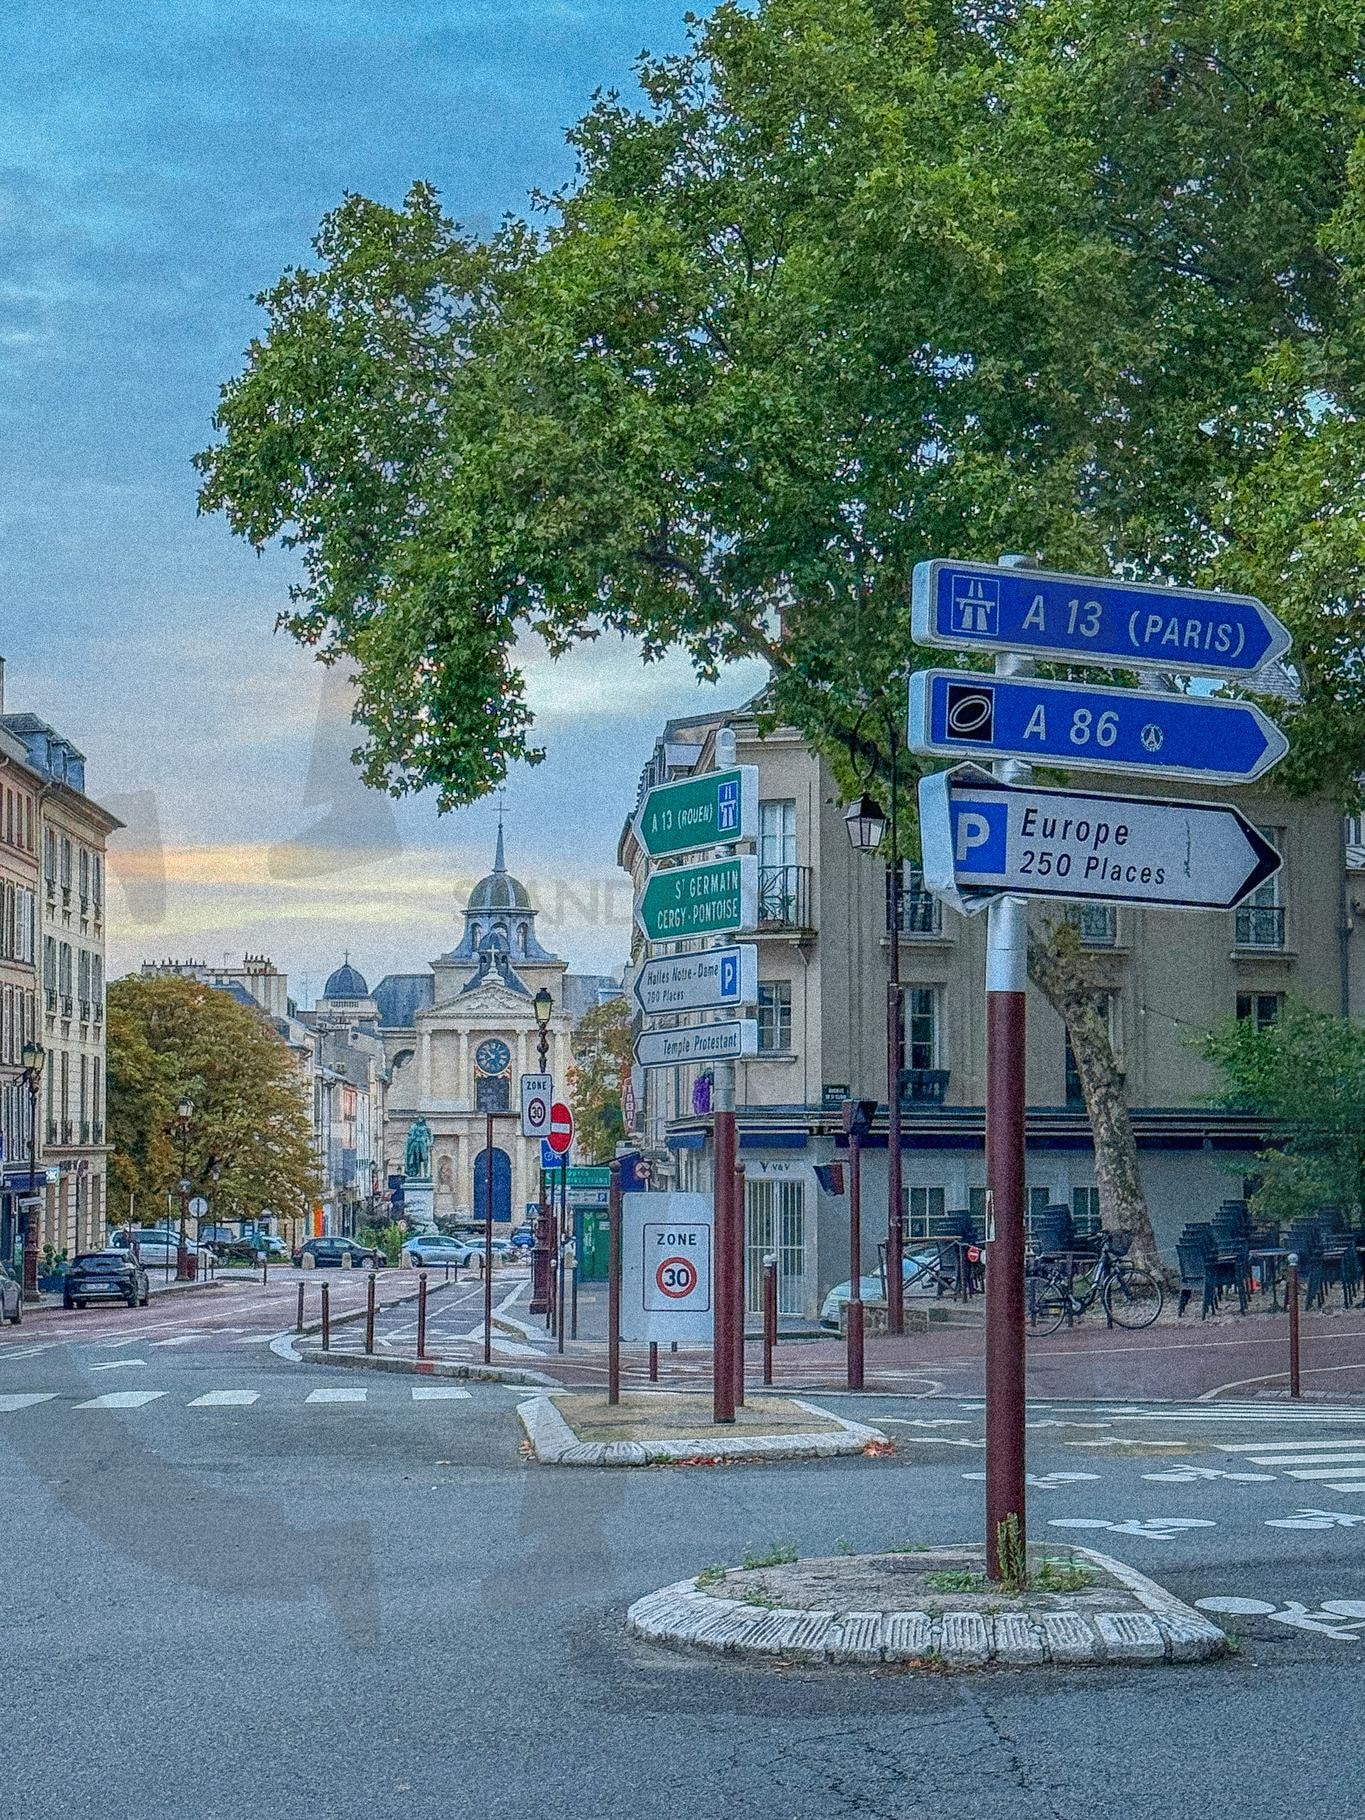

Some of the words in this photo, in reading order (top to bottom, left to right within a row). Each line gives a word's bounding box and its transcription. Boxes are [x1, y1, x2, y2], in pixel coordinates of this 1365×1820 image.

[1022, 594, 1046, 632] A
[1067, 599, 1103, 638] 13
[1129, 609, 1245, 658] (PARIS)
[1023, 703, 1047, 741] A
[1070, 707, 1119, 747] 86
[651, 813, 658, 833] A
[662, 809, 672, 831] 13
[677, 802, 713, 830] (ROUEN)
[1020, 808, 1129, 850] Europe
[956, 812, 991, 861] P
[1019, 849, 1071, 878] 250
[1084, 856, 1165, 886] Places
[689, 869, 738, 897] GERMAIN
[724, 962, 734, 990] P
[663, 989, 684, 1003] Places
[663, 1037, 690, 1057] Temple
[694, 1033, 737, 1051] Protestant
[526, 1080, 547, 1091] ZONE
[531, 1105, 544, 1120] 30
[657, 1233, 697, 1246] ZONE
[664, 1268, 690, 1288] 30
